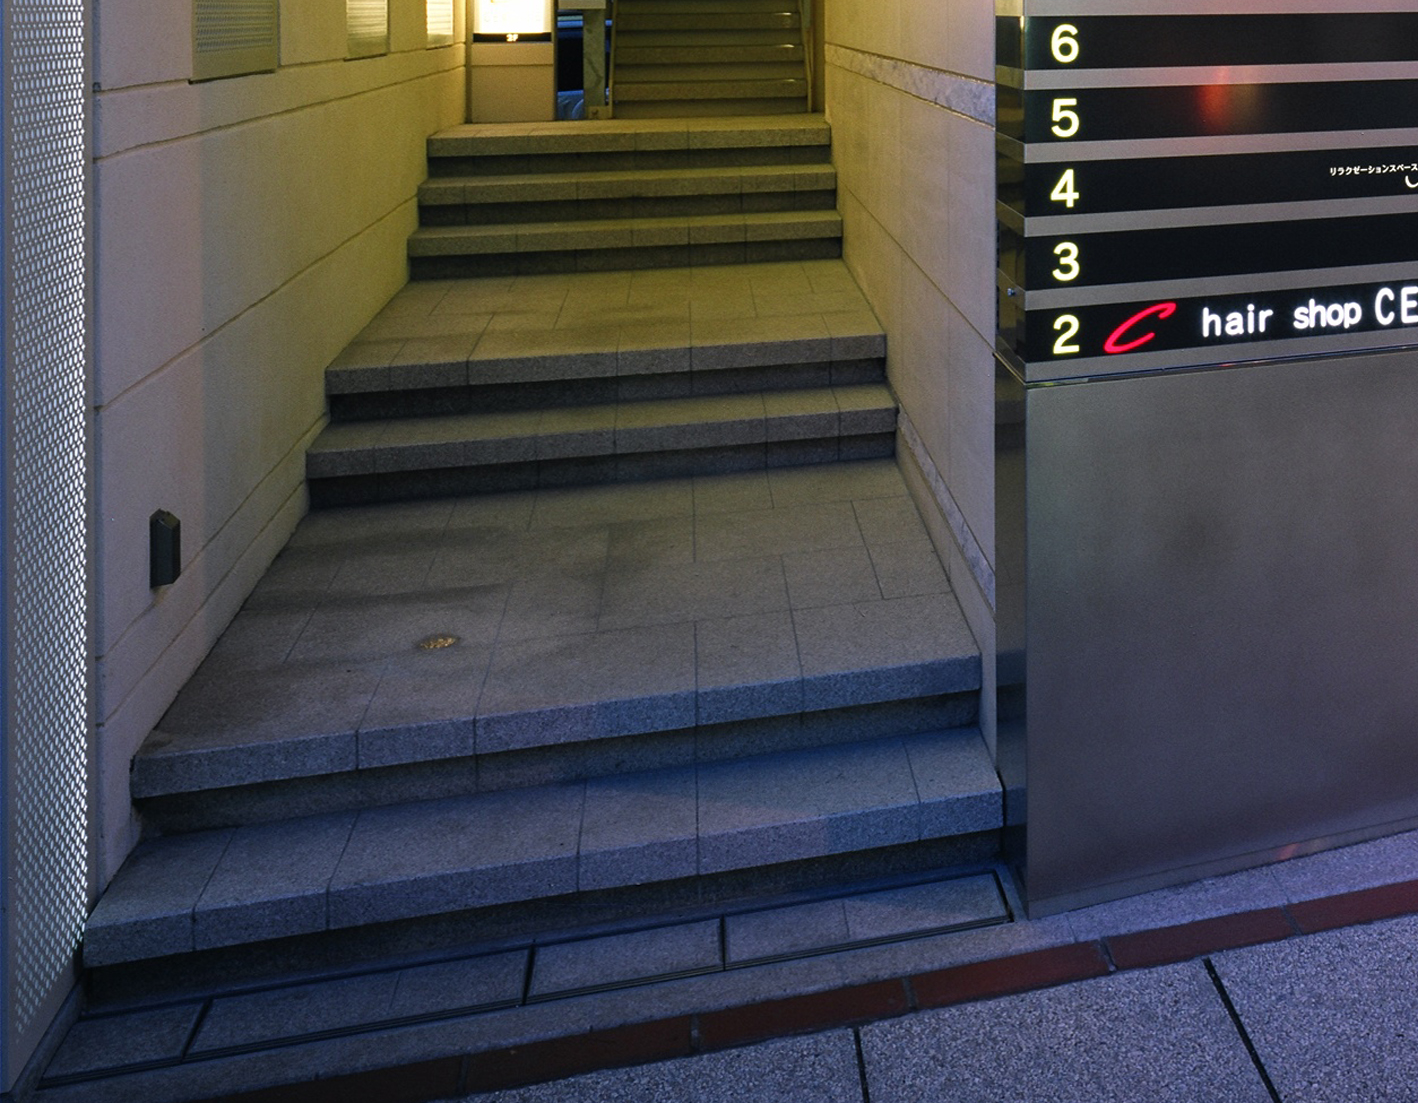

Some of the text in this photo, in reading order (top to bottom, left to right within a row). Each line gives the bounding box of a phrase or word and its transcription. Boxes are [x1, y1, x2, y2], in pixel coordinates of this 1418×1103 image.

[1050, 23, 1080, 64] 6
[1051, 97, 1080, 138] 5
[1050, 168, 1080, 208] 4
[1329, 163, 1418, 177] リラクゼーションスペース
[1052, 241, 1080, 282] 3
[1052, 314, 1080, 355] 2
[1202, 303, 1274, 338] hair
[1292, 298, 1363, 330] shop
